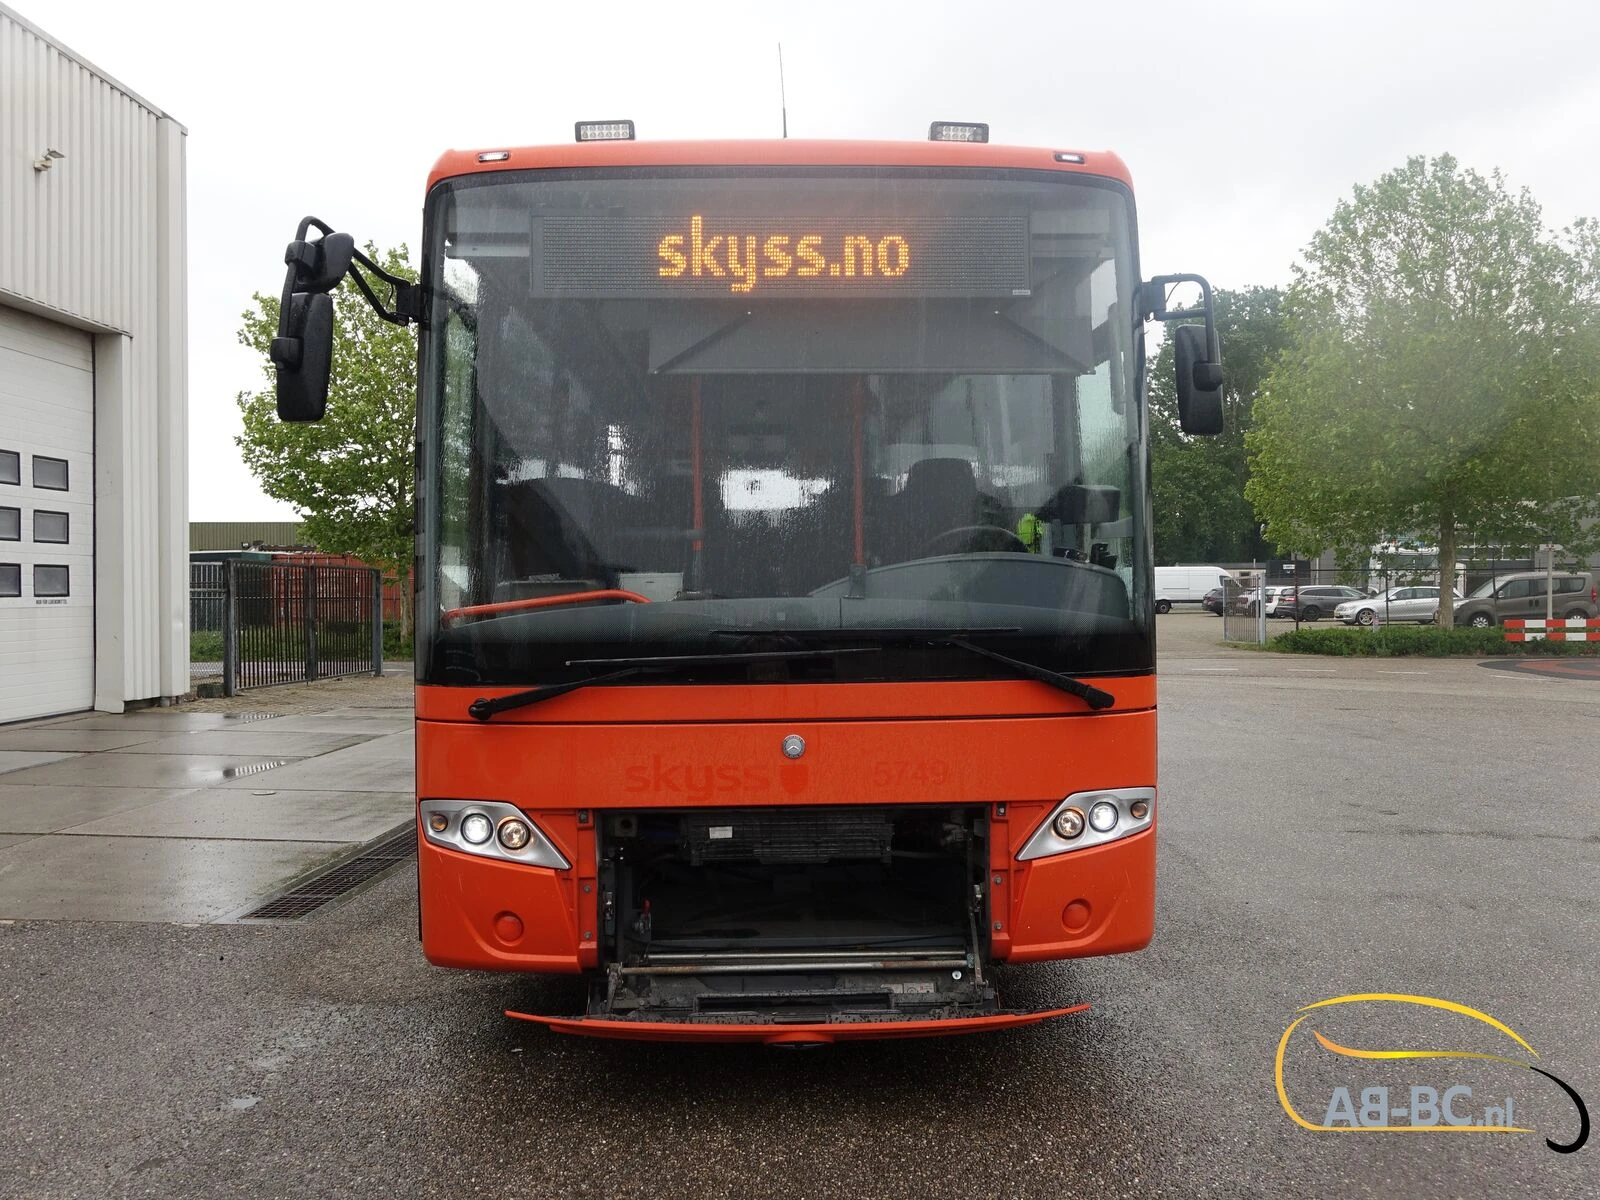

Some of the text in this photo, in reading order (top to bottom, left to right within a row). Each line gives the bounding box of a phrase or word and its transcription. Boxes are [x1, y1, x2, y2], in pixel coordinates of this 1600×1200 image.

[658, 215, 910, 293] skyss.no
[624, 753, 771, 801] skyss
[873, 759, 950, 788] 5749
